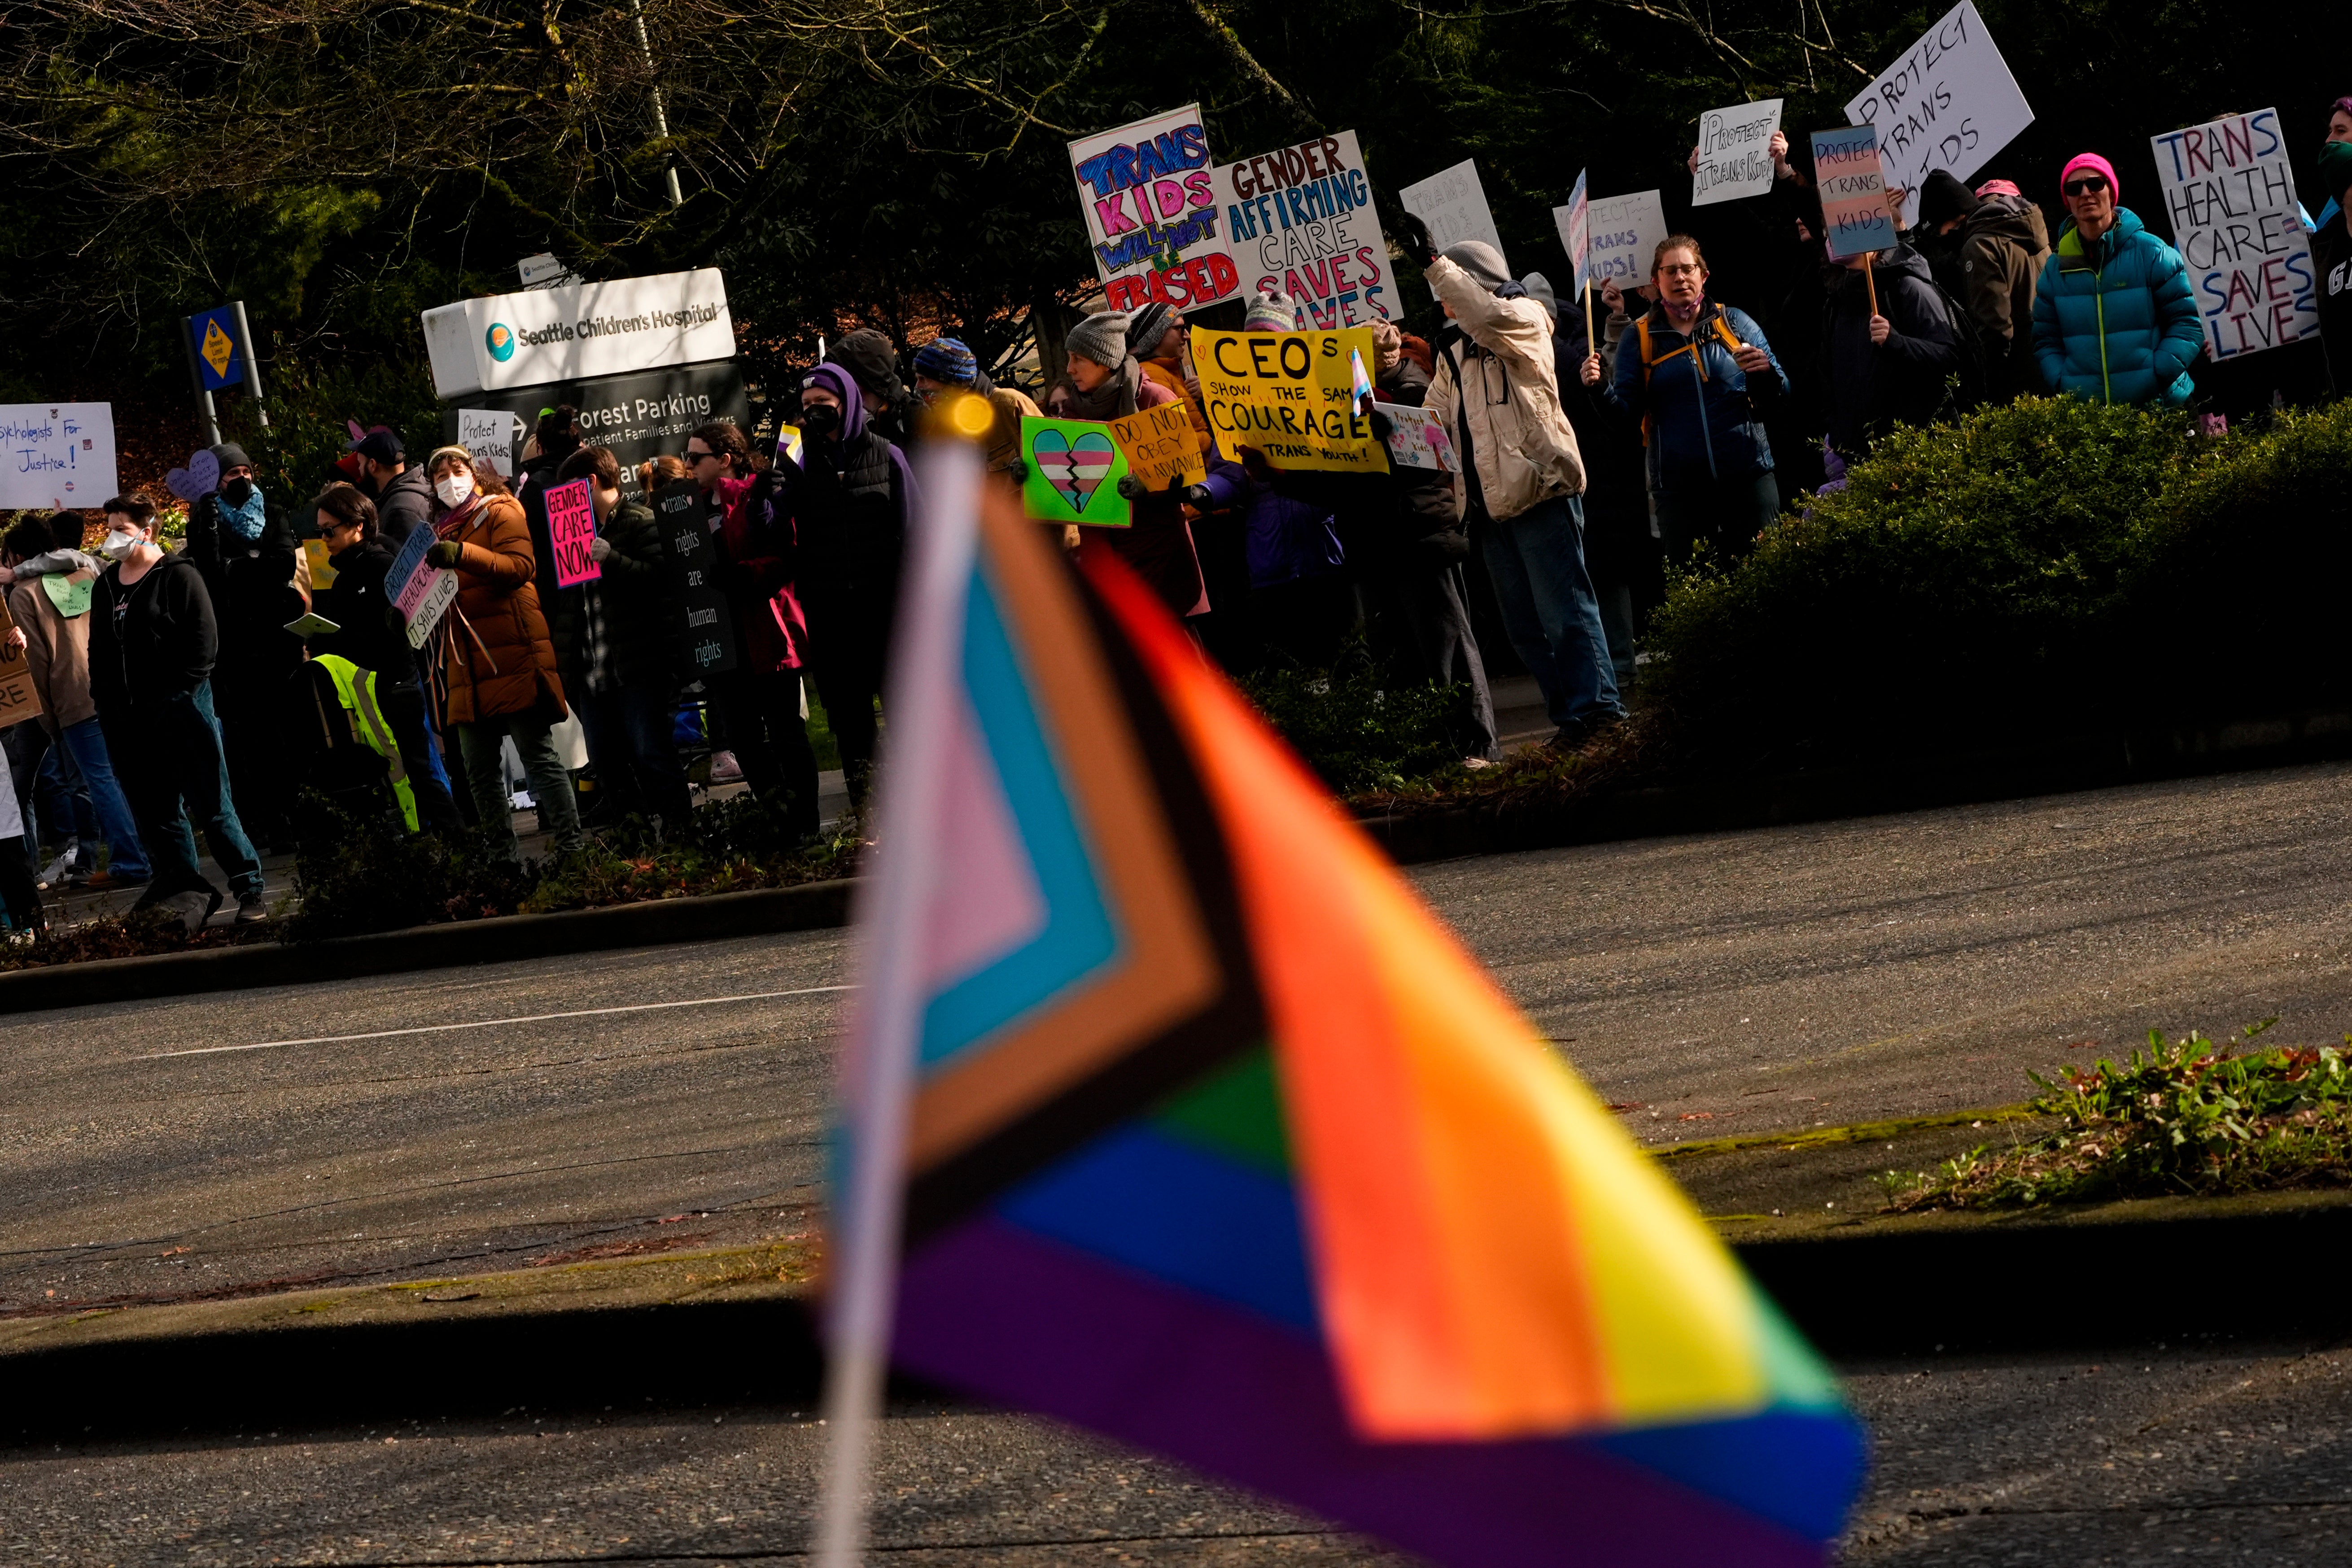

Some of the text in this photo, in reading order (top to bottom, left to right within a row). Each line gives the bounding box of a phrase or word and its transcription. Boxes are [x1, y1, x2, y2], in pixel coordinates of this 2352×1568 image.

[1859, 8, 1967, 124] PROTECT
[1705, 114, 1772, 156] PROTECT
[1879, 81, 1951, 169] TRANS
[1076, 124, 1210, 199] TRANS
[1816, 138, 1877, 167] PROTECT
[1901, 118, 1978, 206] KIDS
[2157, 113, 2278, 182] TRANS
[1232, 137, 1346, 200] GENDER
[1696, 151, 1773, 190] TRANS KIDS
[1821, 175, 1878, 194] TRANS
[1093, 171, 1214, 238] KIDS
[1228, 168, 1368, 244] AFFIRMING
[1411, 174, 1469, 214] TRANS
[2169, 162, 2290, 230] HEALTH
[1094, 205, 1218, 274] WILL NOT
[1837, 207, 1884, 235] KIDS
[2186, 212, 2289, 270] CARE
[1150, 249, 1183, 273] BE
[1259, 212, 1359, 271] CARE
[1256, 246, 1380, 303] SAVES
[2203, 252, 2312, 317] SAVES
[519, 302, 717, 346] Seattle Children's Hospital
[1294, 286, 1390, 331] IVES
[2211, 293, 2320, 359] LIVES
[209, 338, 223, 348] Speed
[212, 348, 223, 356] Limit
[573, 393, 711, 429] orest Parking
[1210, 381, 1354, 402] SHOW THE SAM
[63, 419, 82, 438] For
[463, 415, 497, 440] Protect
[625, 426, 670, 441] Families
[673, 420, 693, 434] and
[1115, 402, 1186, 444] DO NOT
[1211, 399, 1369, 440] COURAGE
[489, 441, 511, 459] Kids!
[1137, 432, 1183, 461] OBEY
[1153, 450, 1204, 479] ADVANCE
[1263, 443, 1312, 457] TRANS
[547, 482, 587, 514] GENDER
[665, 494, 688, 513] trans
[553, 508, 592, 543] CARE
[675, 528, 699, 556] rights
[385, 522, 433, 600] PROTECT TRANS
[556, 538, 594, 580] NOW
[688, 570, 703, 586] are
[400, 561, 435, 614] HEALTHCAR
[408, 573, 455, 646] IT SAVES LIVES
[686, 607, 717, 628] human
[695, 639, 722, 667] rights
